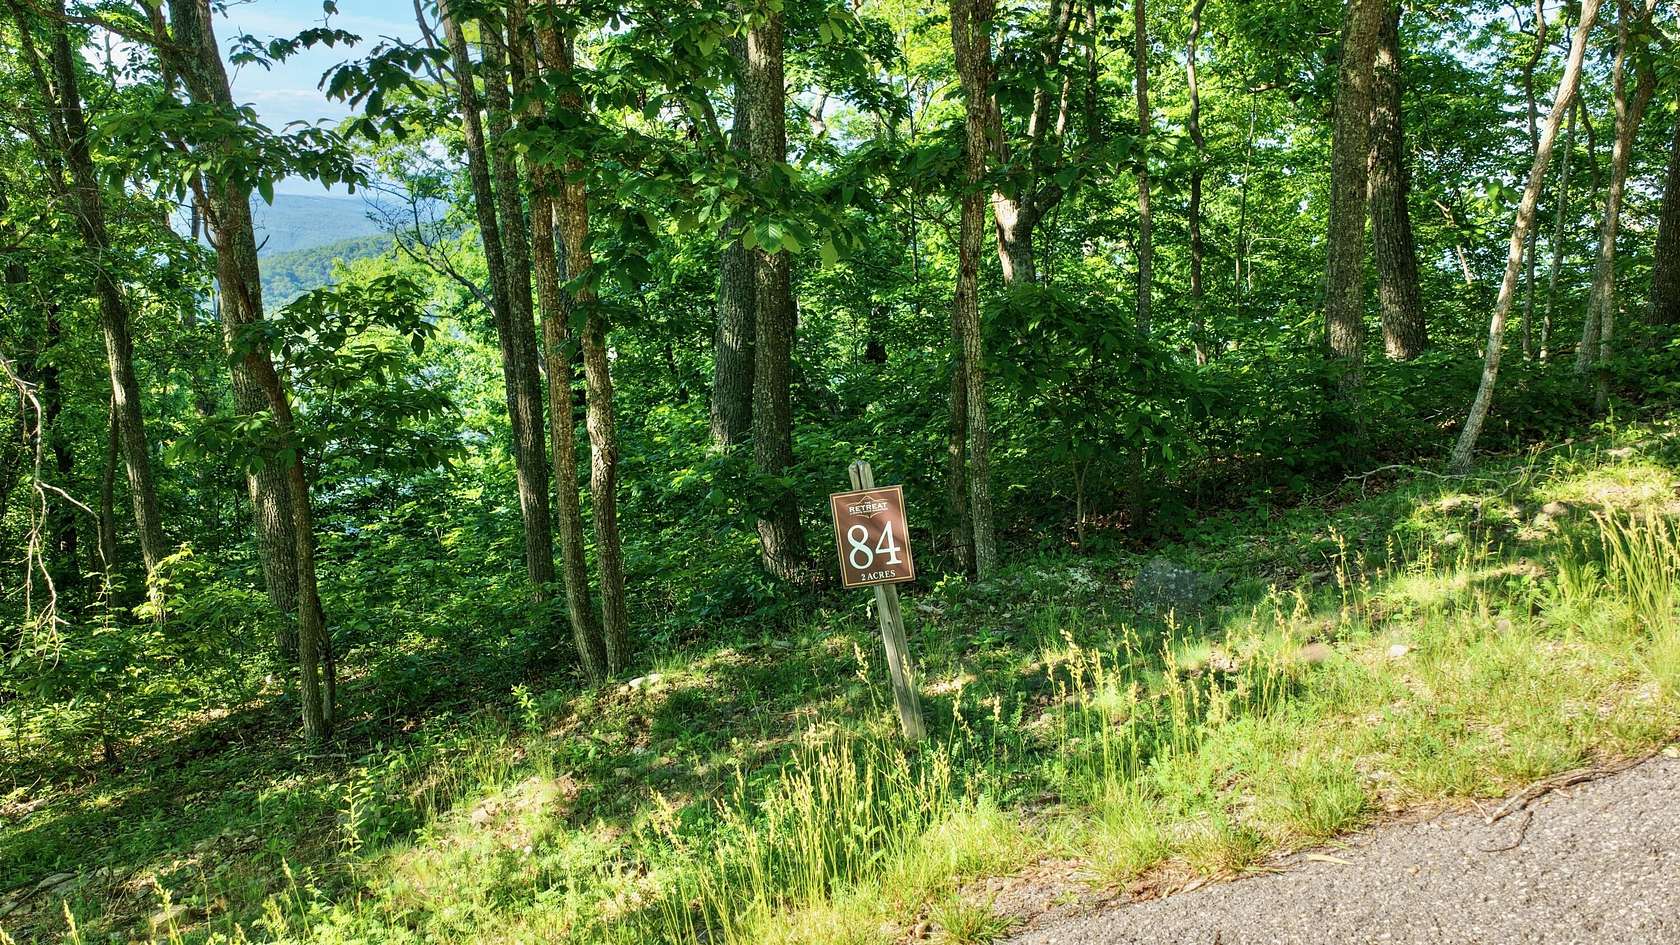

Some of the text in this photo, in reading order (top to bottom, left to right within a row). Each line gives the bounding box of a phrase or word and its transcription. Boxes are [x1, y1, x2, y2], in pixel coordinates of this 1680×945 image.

[849, 502, 888, 513] RETREAT
[847, 520, 902, 570] 84
[861, 570, 896, 581] 2 ACRES
